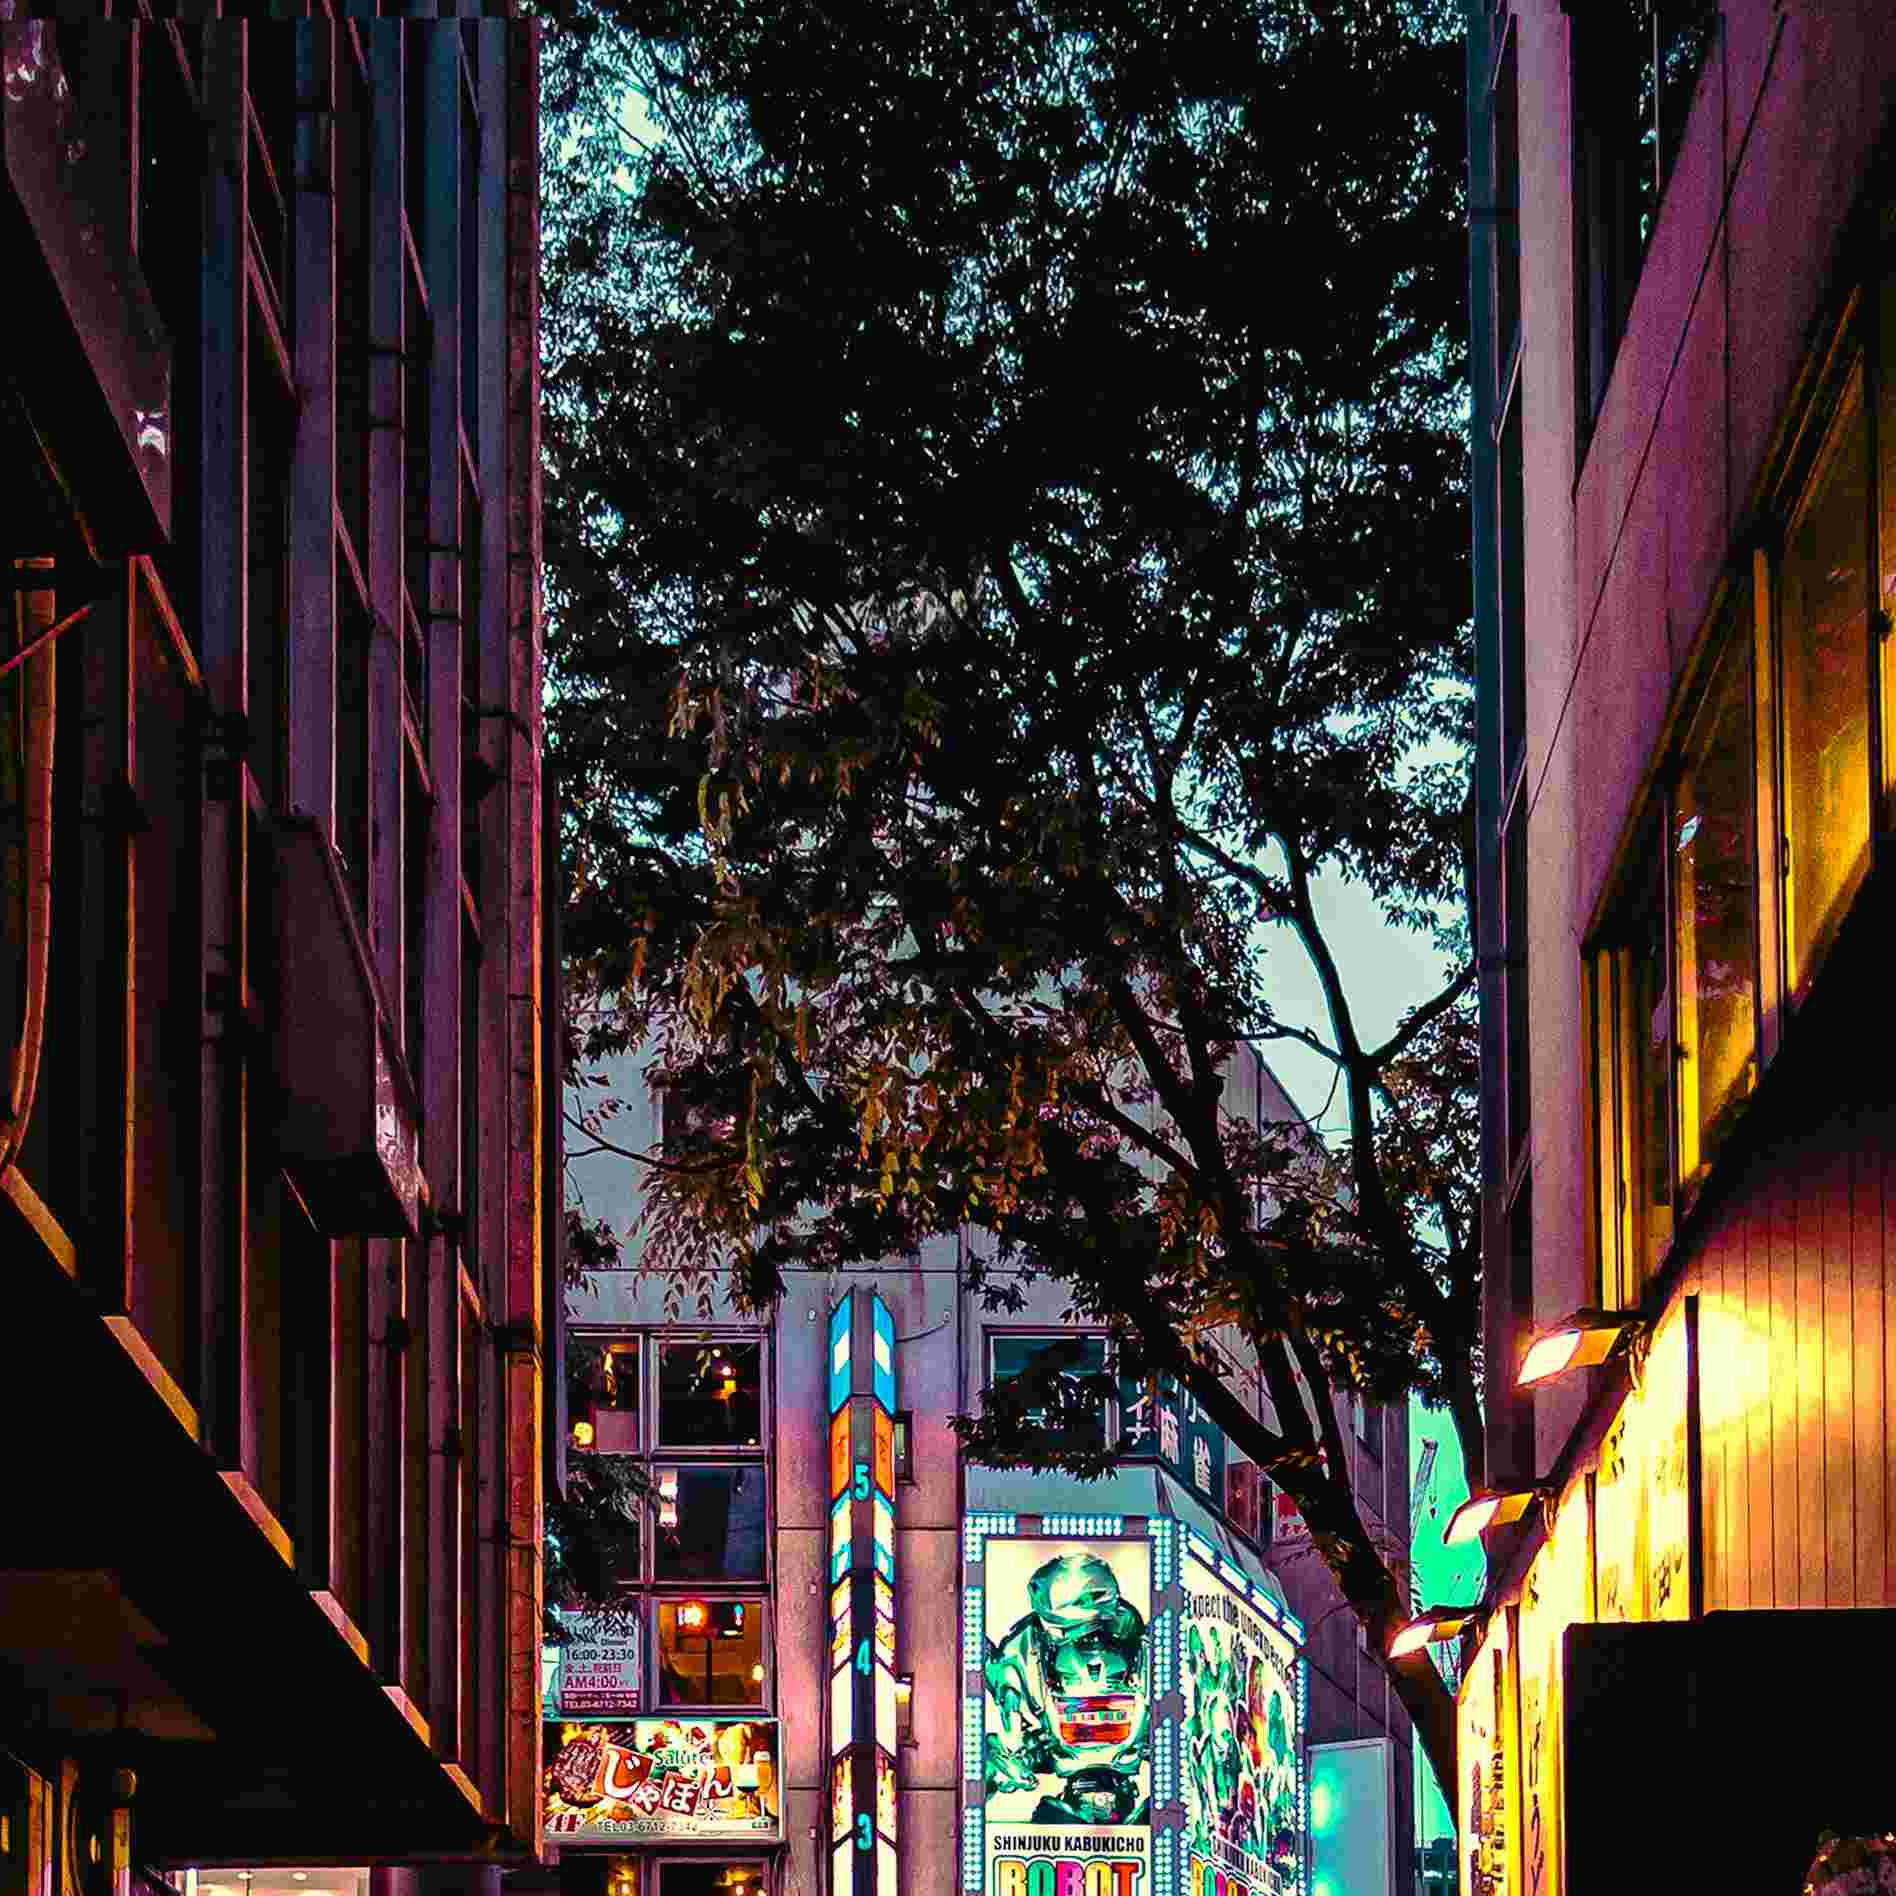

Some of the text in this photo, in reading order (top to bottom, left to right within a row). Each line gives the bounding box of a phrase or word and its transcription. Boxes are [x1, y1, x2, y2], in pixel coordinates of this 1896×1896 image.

[855, 1463, 870, 1500] 5
[856, 1639, 872, 1676] 4
[857, 1813, 872, 1851] 3
[993, 1835, 1145, 1852] SHINJUKU KABUKICHO
